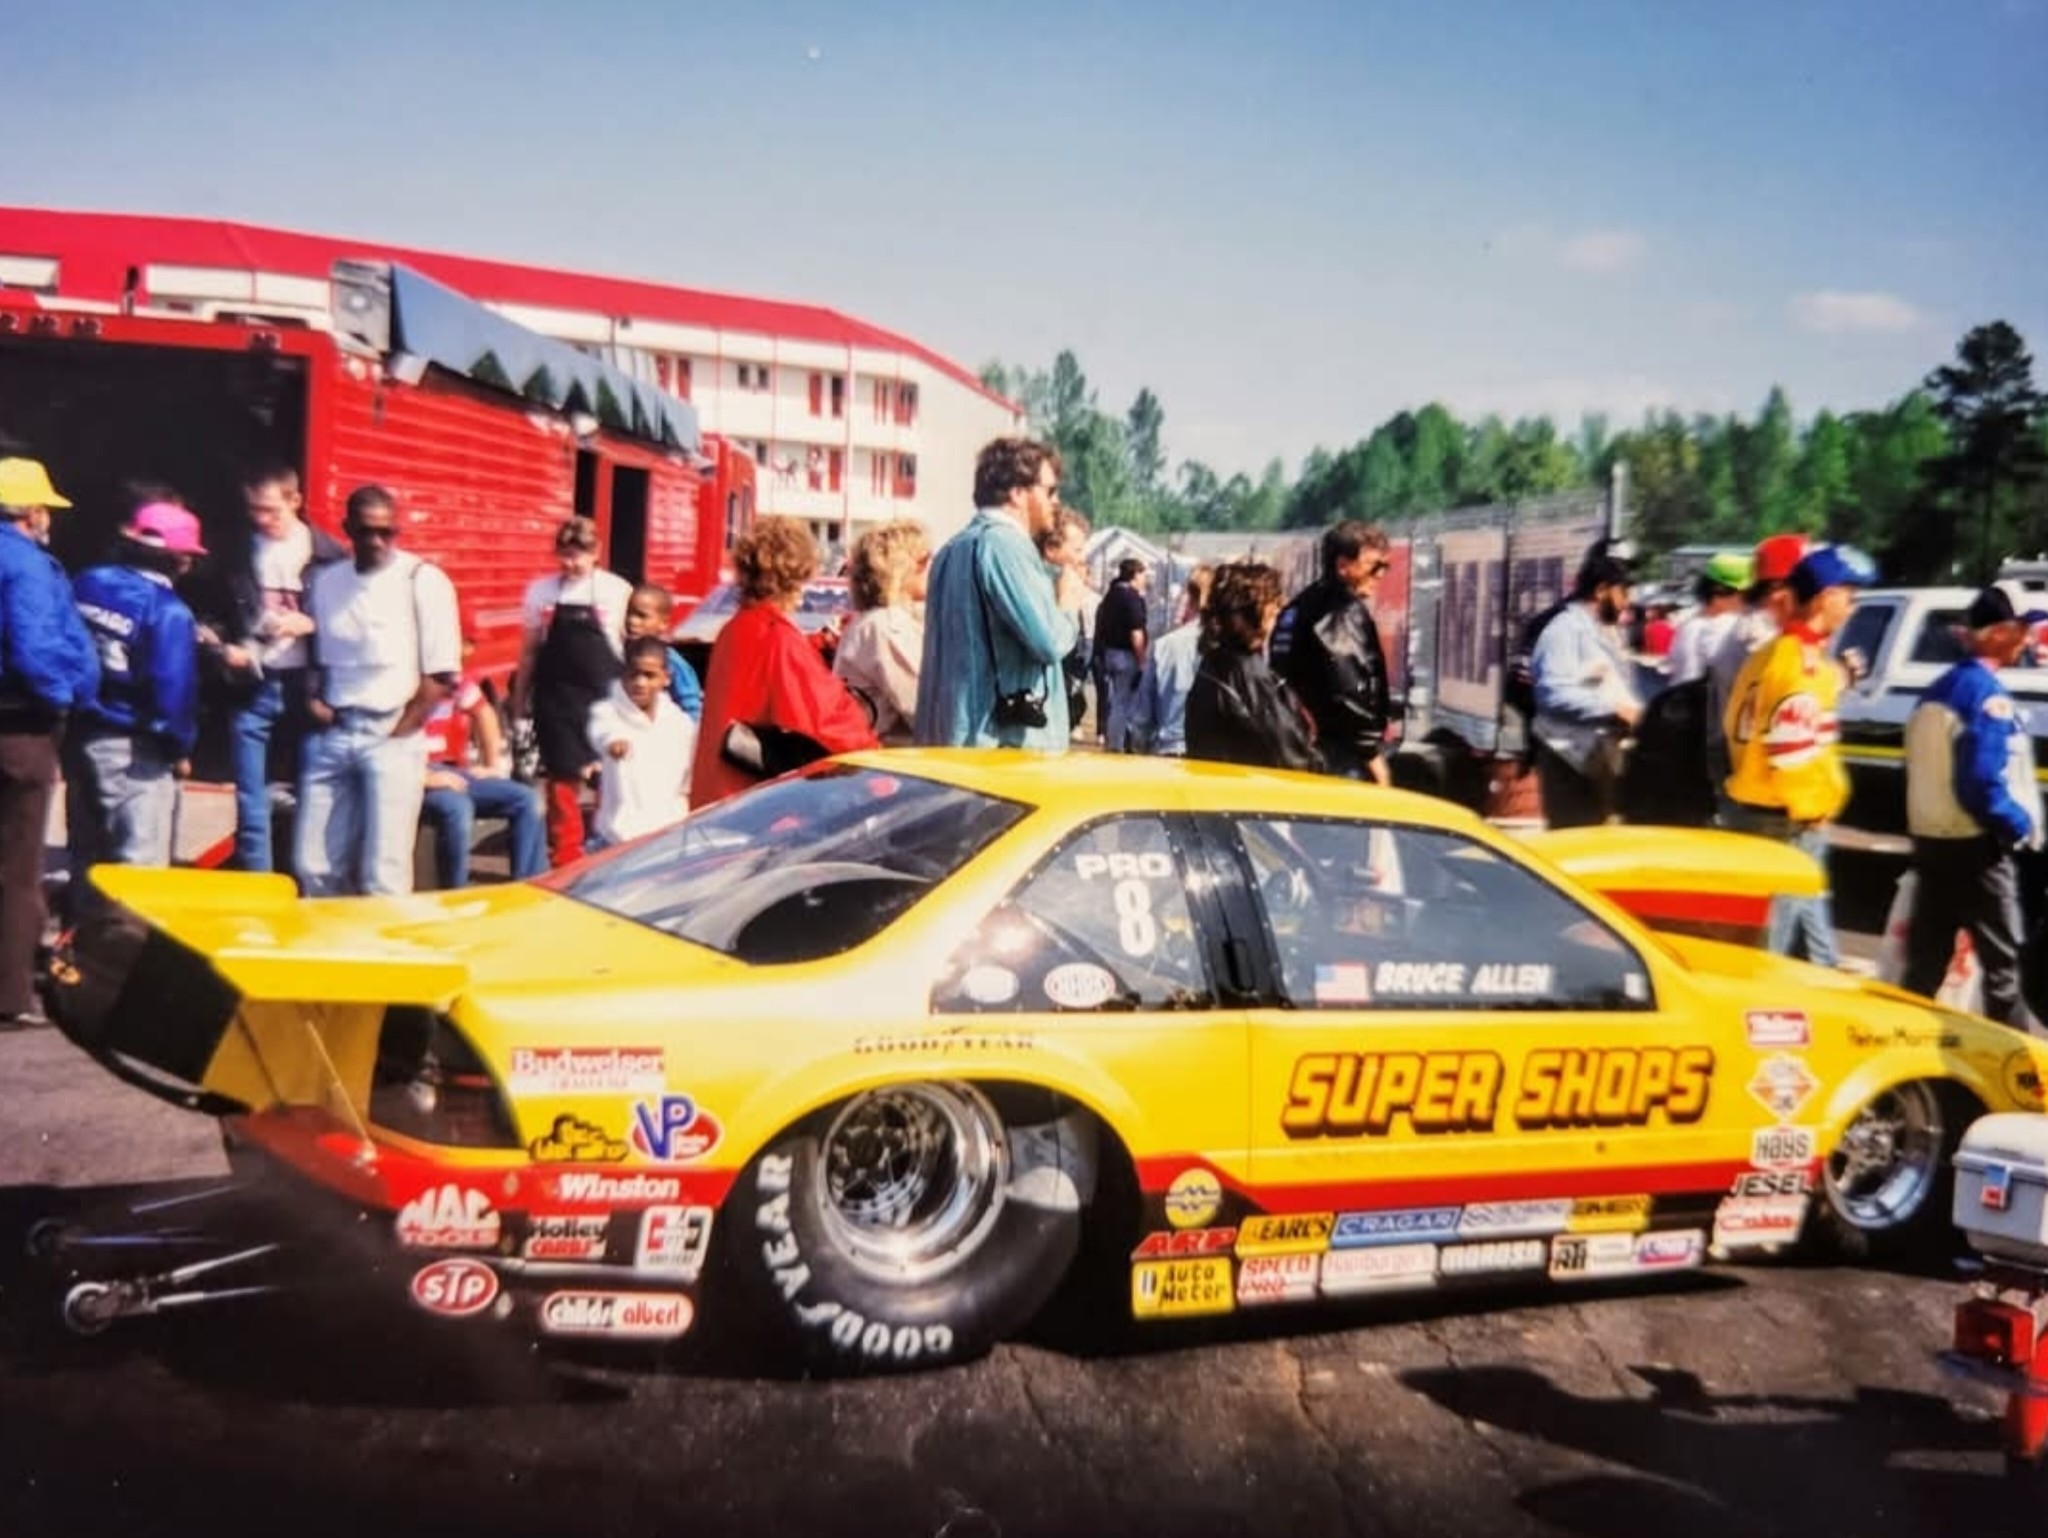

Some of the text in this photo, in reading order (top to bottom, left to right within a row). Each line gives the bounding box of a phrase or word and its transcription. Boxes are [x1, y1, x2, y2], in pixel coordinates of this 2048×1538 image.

[1074, 853, 1172, 880] PRO
[1113, 880, 1156, 957] 8
[1375, 962, 1552, 994] BRUCE ALLEN
[512, 1048, 664, 1075] Budweiser
[1281, 1050, 1505, 1140] SUPER
[1515, 1046, 1716, 1130] SHOPS
[636, 1096, 694, 1160] VP
[558, 1173, 680, 1202] Winston
[1731, 1173, 1812, 1197] JESEL
[400, 1184, 499, 1228] MAC
[530, 1218, 606, 1241] Holley
[1339, 1210, 1452, 1235] CRAGAR
[1136, 1228, 1237, 1256] ARP
[1164, 1263, 1216, 1284] Auto
[1245, 1255, 1310, 1275] SPEED
[423, 1263, 487, 1302] STP
[1160, 1282, 1225, 1307] Meter
[623, 1301, 680, 1325] albert
